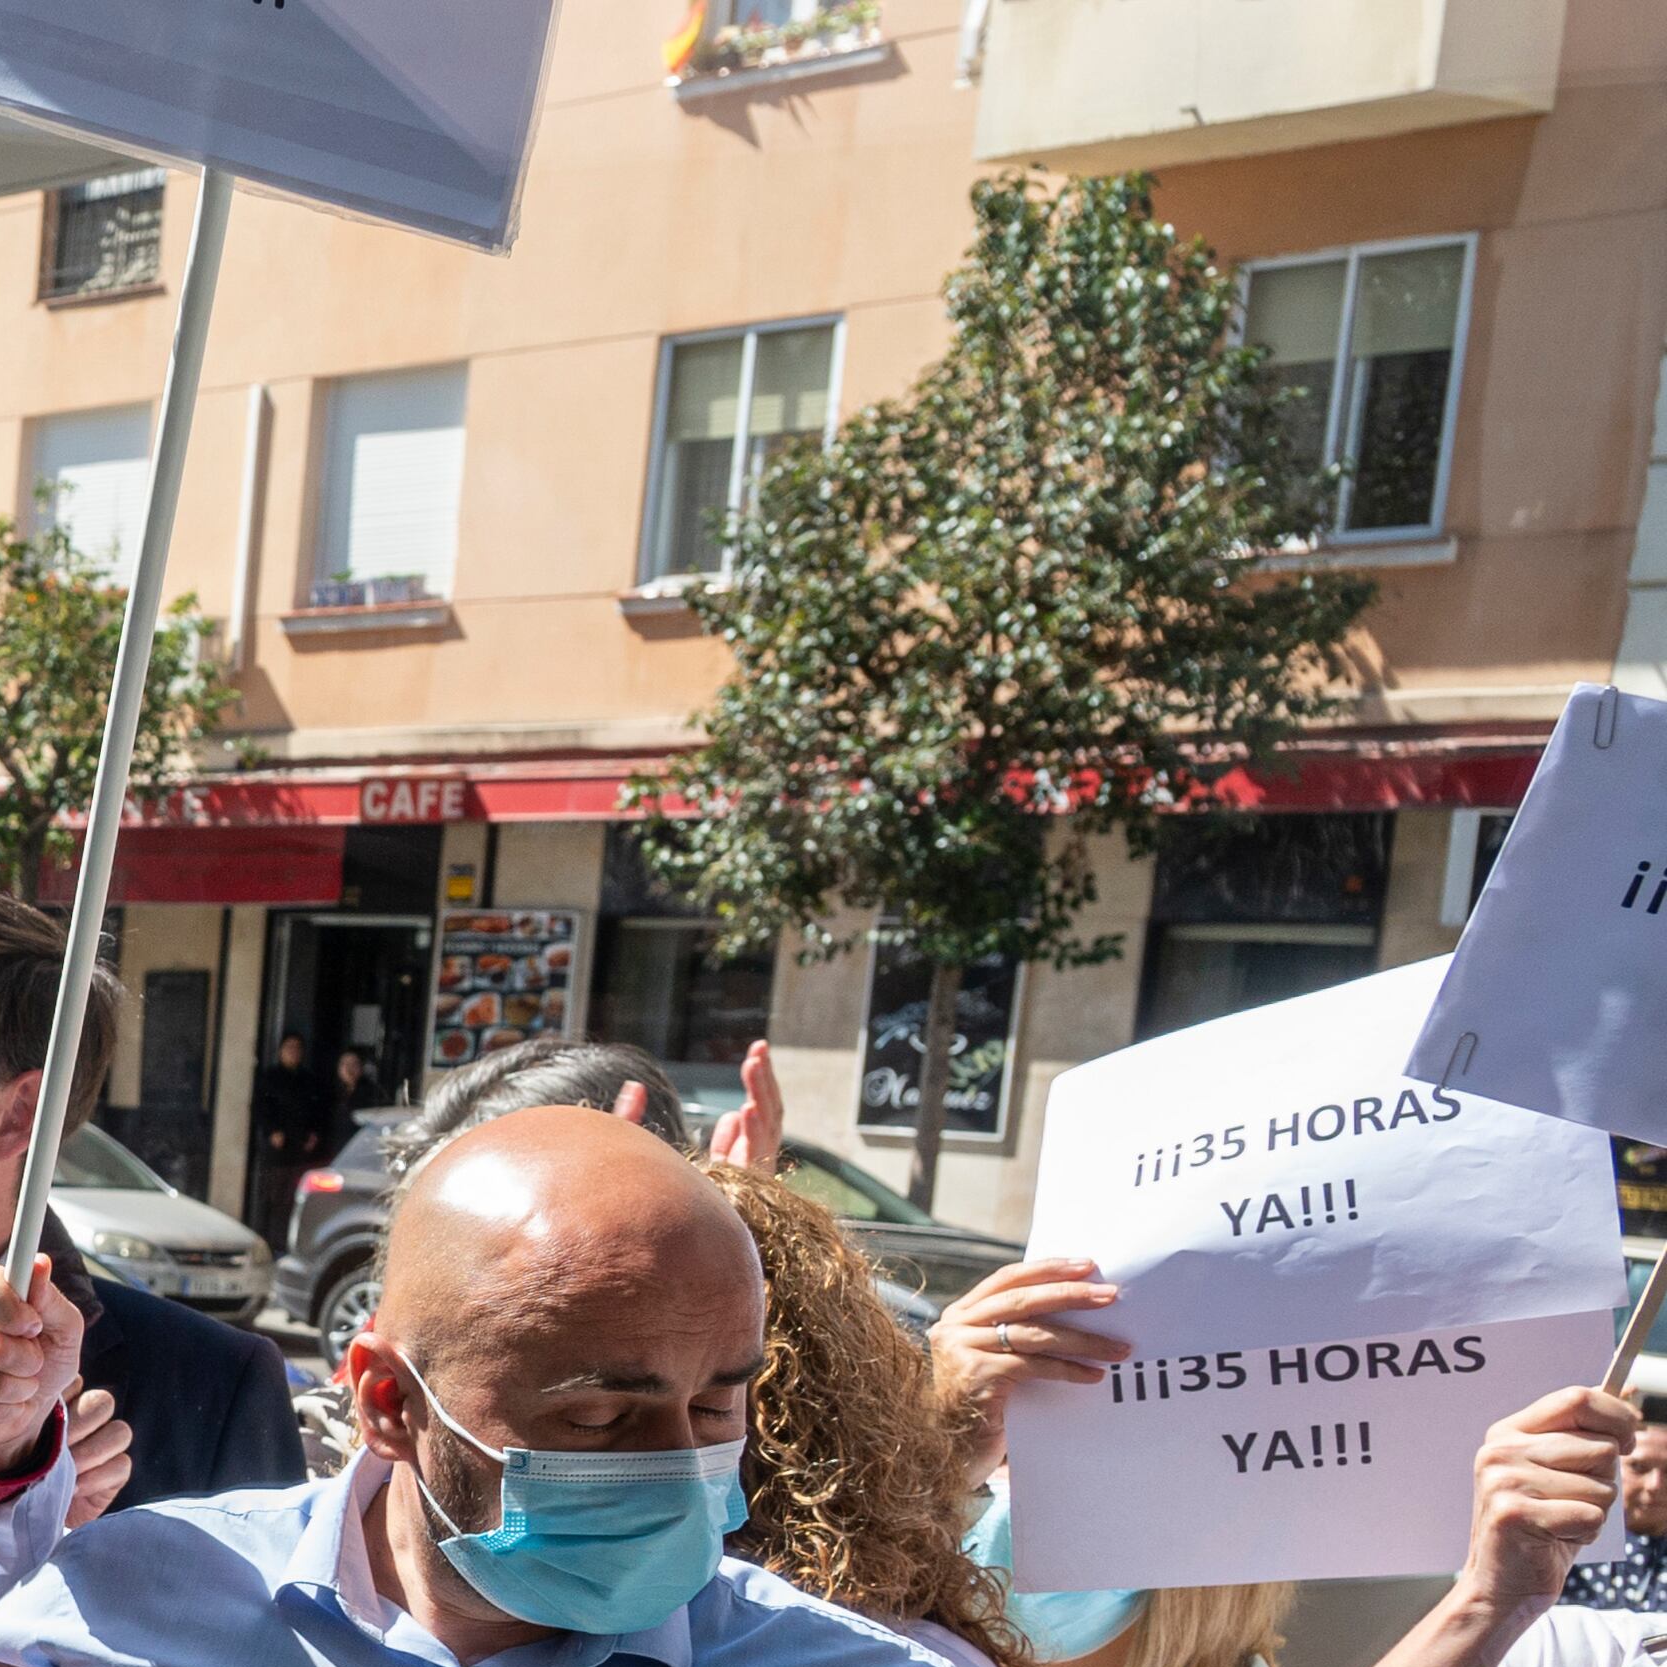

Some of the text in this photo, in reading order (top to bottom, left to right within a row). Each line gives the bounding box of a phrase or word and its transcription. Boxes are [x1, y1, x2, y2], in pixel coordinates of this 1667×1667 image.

[362, 779, 466, 820] CAFE
[1134, 1085, 1462, 1187] ¡¡¡35 HORAS
[1220, 1179, 1359, 1237] YA!!!
[1110, 1335, 1487, 1404] ¡¡¡35 HORAS
[1221, 1421, 1372, 1474] YA!!!
